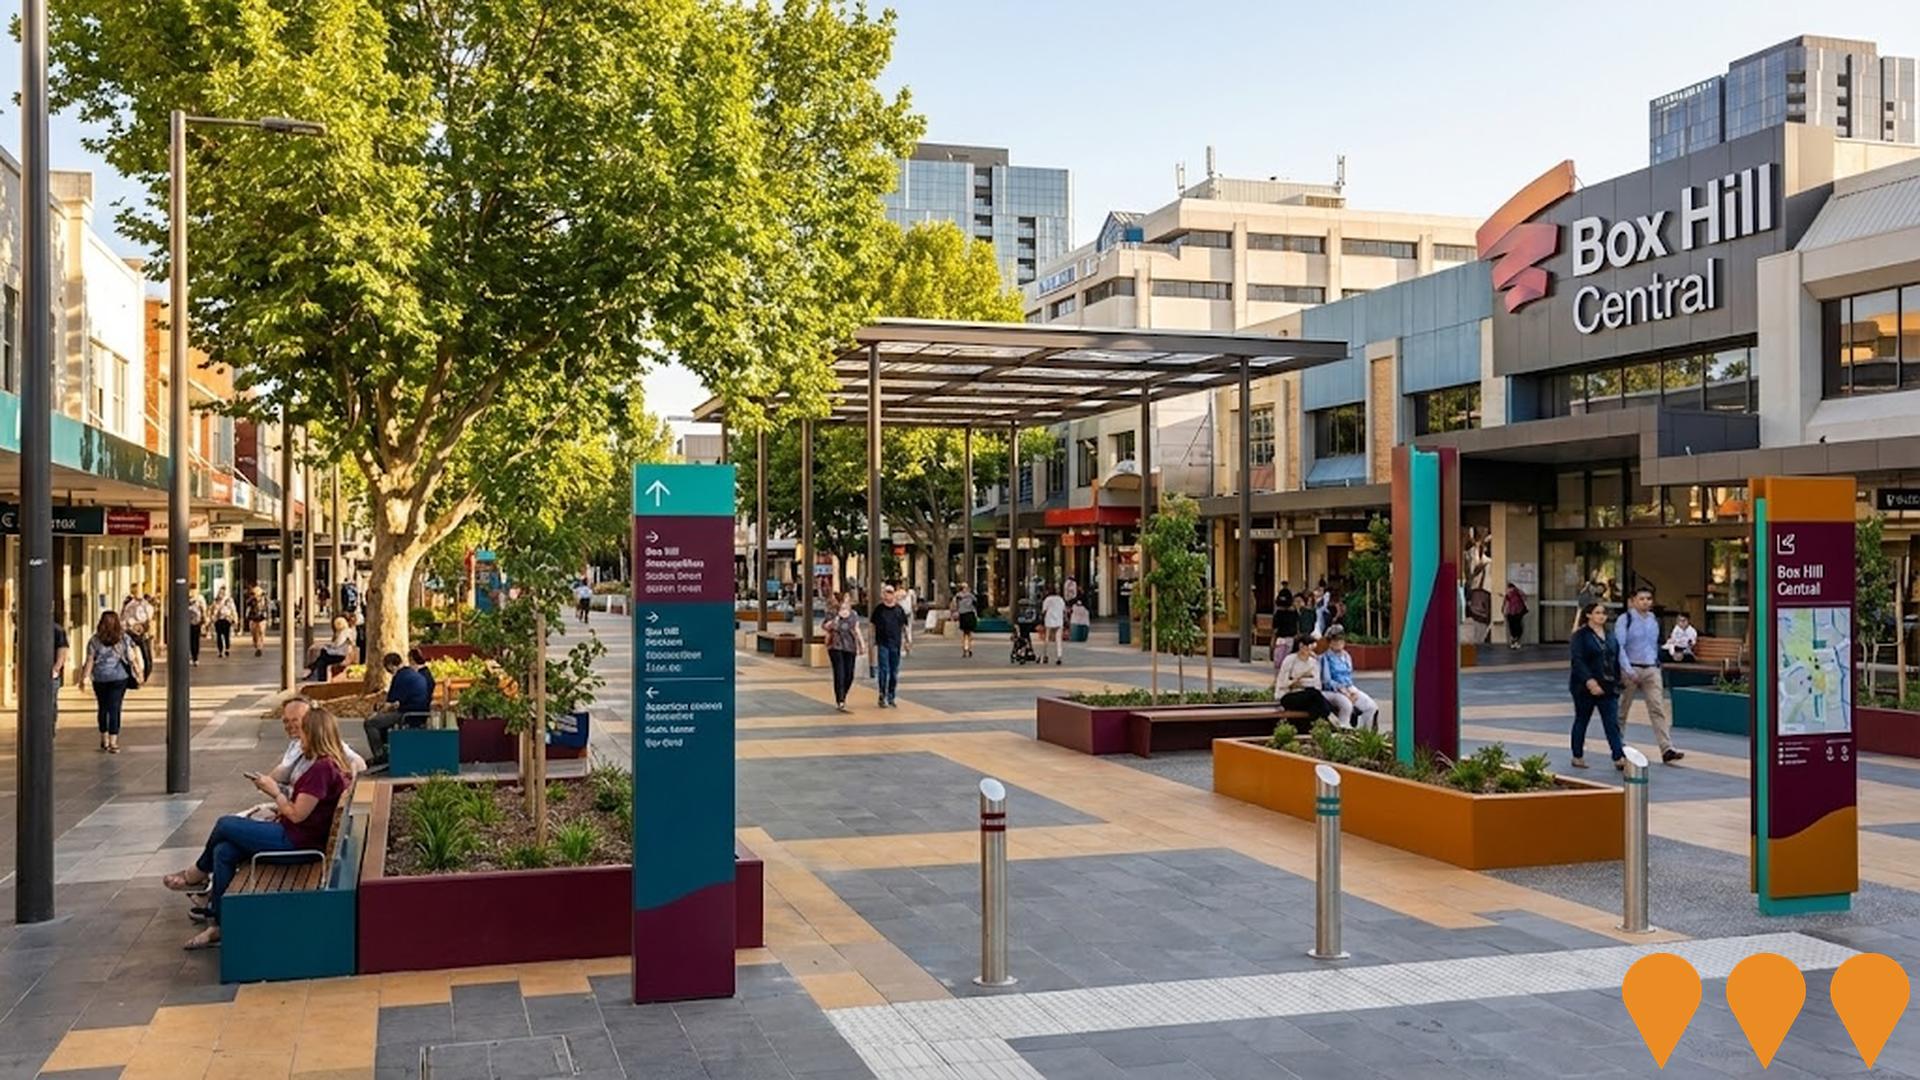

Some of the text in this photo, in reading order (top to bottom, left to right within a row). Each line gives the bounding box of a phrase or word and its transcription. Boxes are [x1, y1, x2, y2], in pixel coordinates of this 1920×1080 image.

[1571, 163, 1774, 277] Box Hill
[1572, 258, 1718, 335] Central
[1777, 581, 1821, 596] Central
[1803, 564, 1824, 579] Hill
